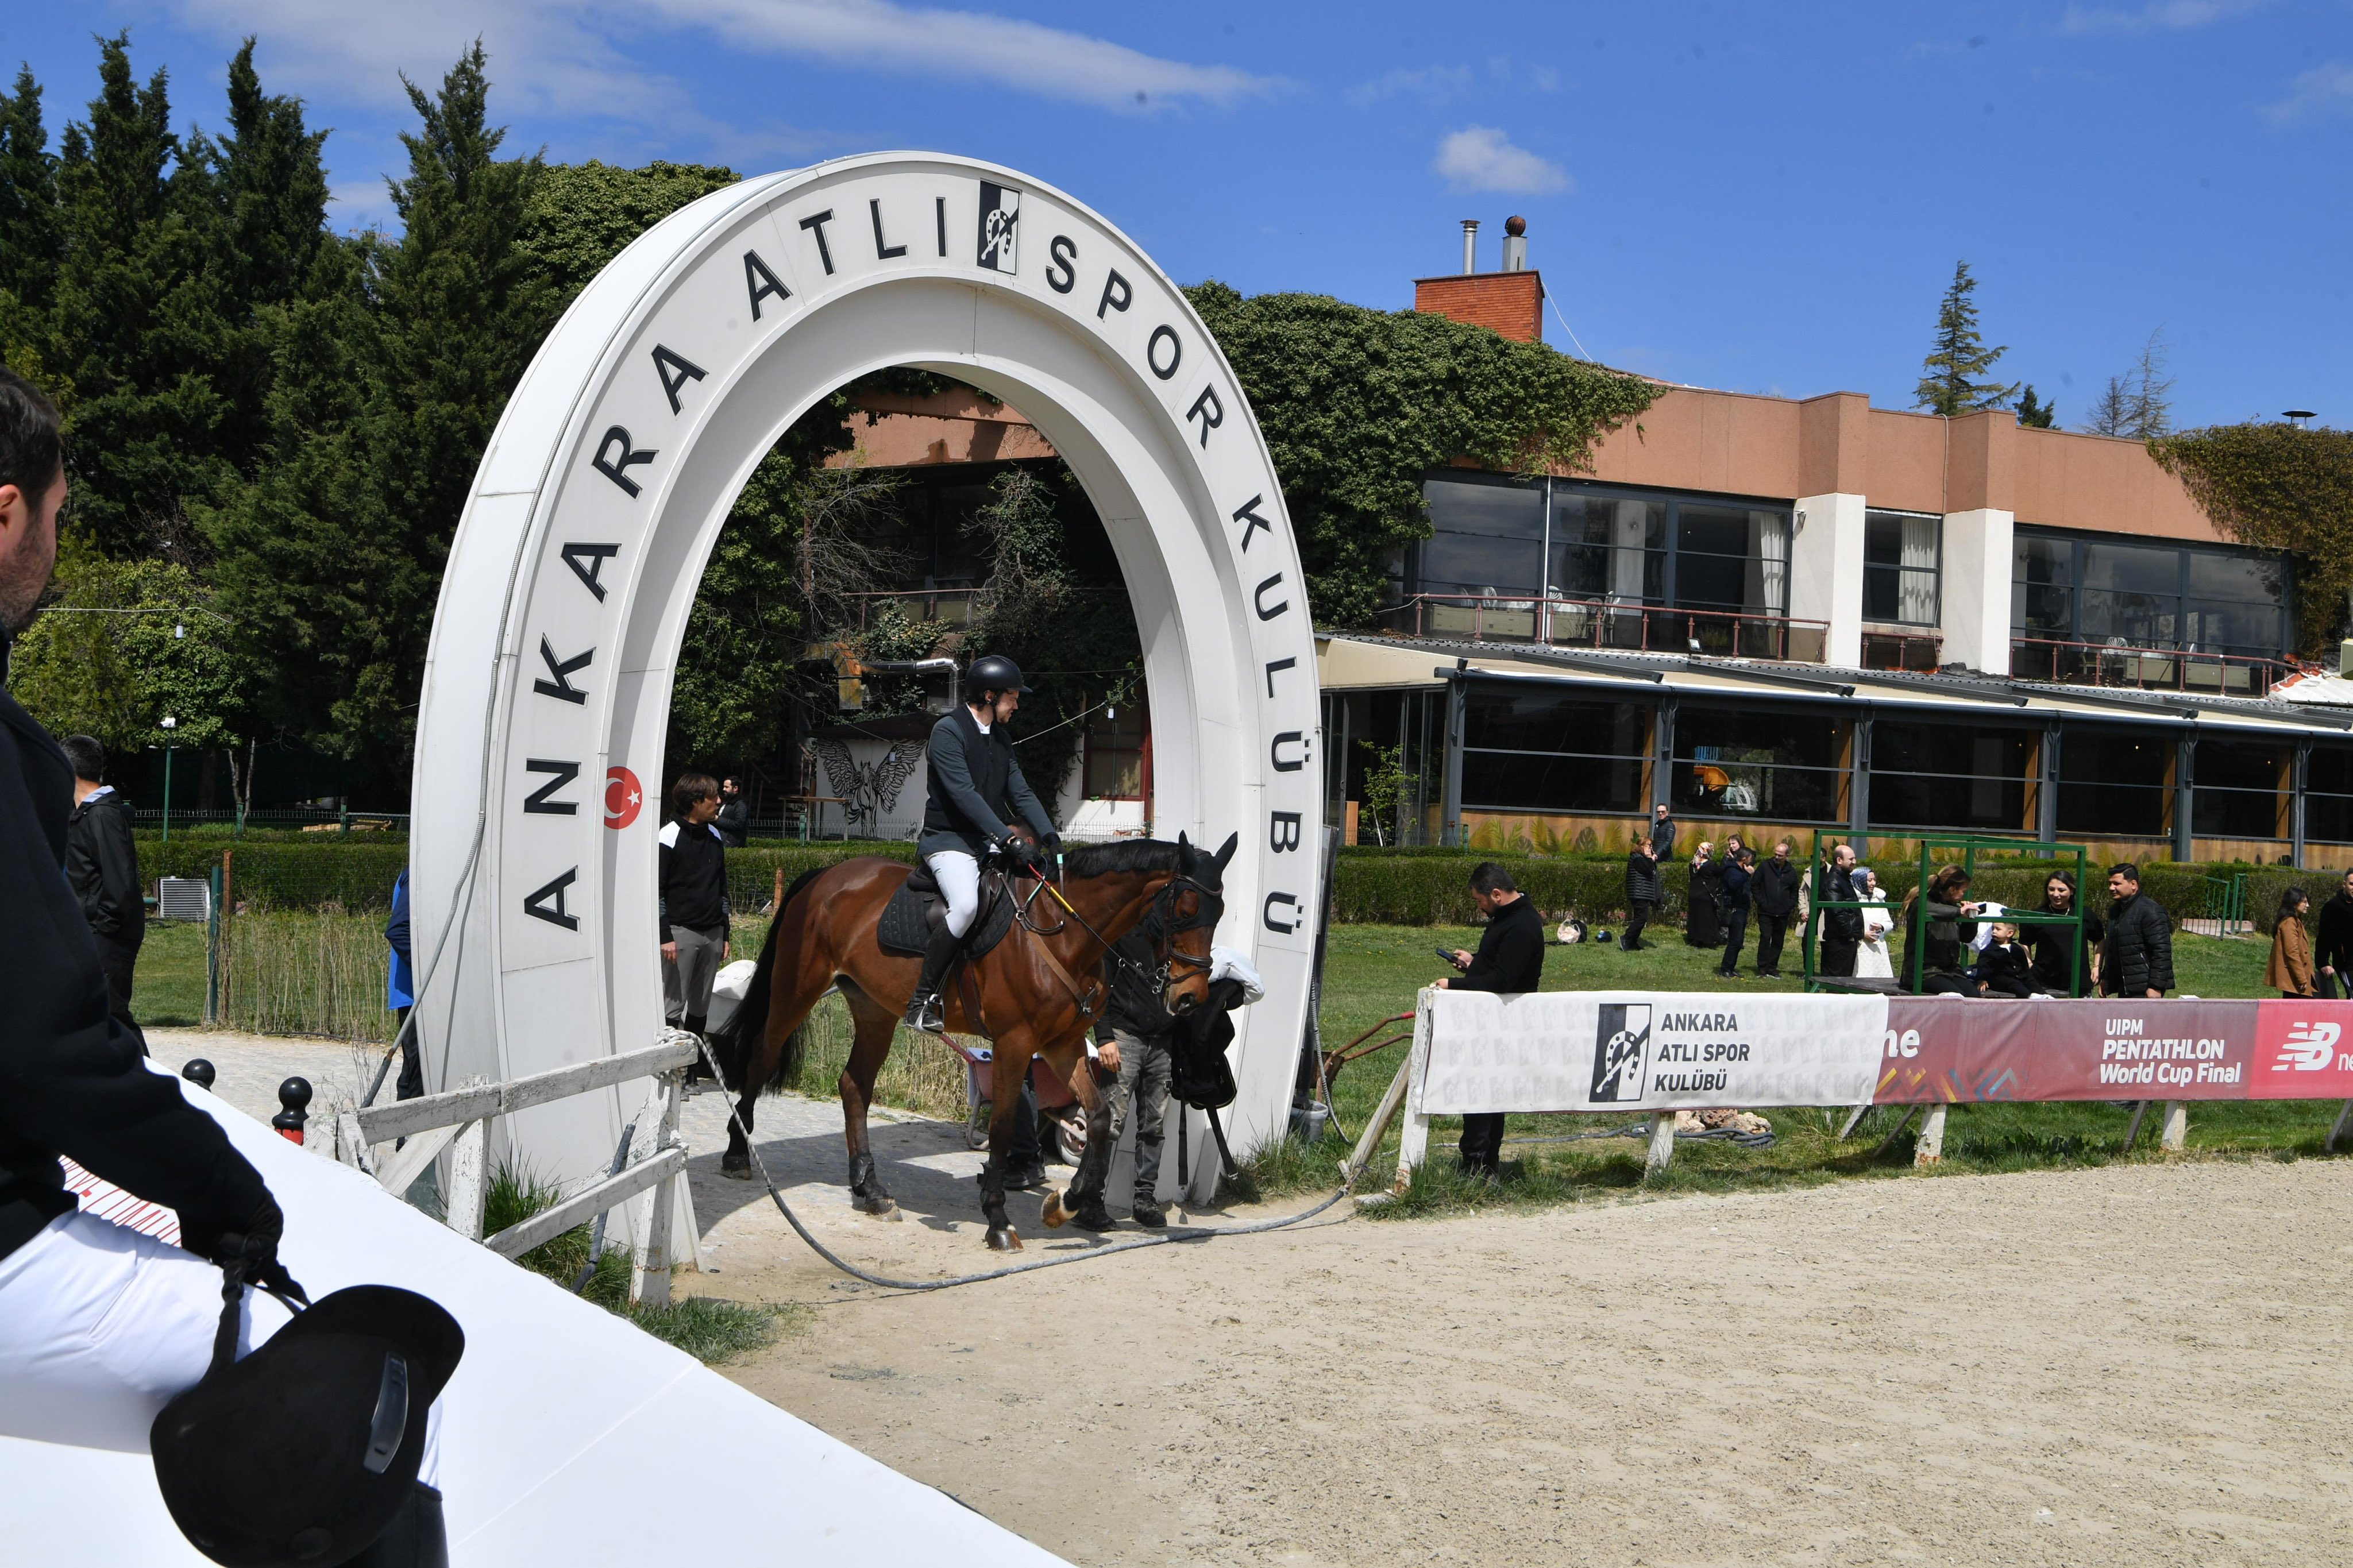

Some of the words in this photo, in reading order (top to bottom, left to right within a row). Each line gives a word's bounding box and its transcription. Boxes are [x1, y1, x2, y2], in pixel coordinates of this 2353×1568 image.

[523, 345, 707, 932] ANKARA
[743, 198, 947, 322] ATLI
[1045, 235, 1224, 451] SPOR
[1232, 494, 1311, 936] KULÜBÜ
[1661, 1013, 1738, 1032] ANKARA
[2105, 1018, 2143, 1036] UIPM
[1657, 1044, 1699, 1063] ATLI
[1703, 1043, 1750, 1062] SPOR
[2102, 1038, 2225, 1060] PENTATHLON
[1654, 1068, 1727, 1092] KULÜBÜ
[2100, 1061, 2154, 1084] World
[2157, 1063, 2193, 1088] Cup
[2196, 1062, 2242, 1083] Final
